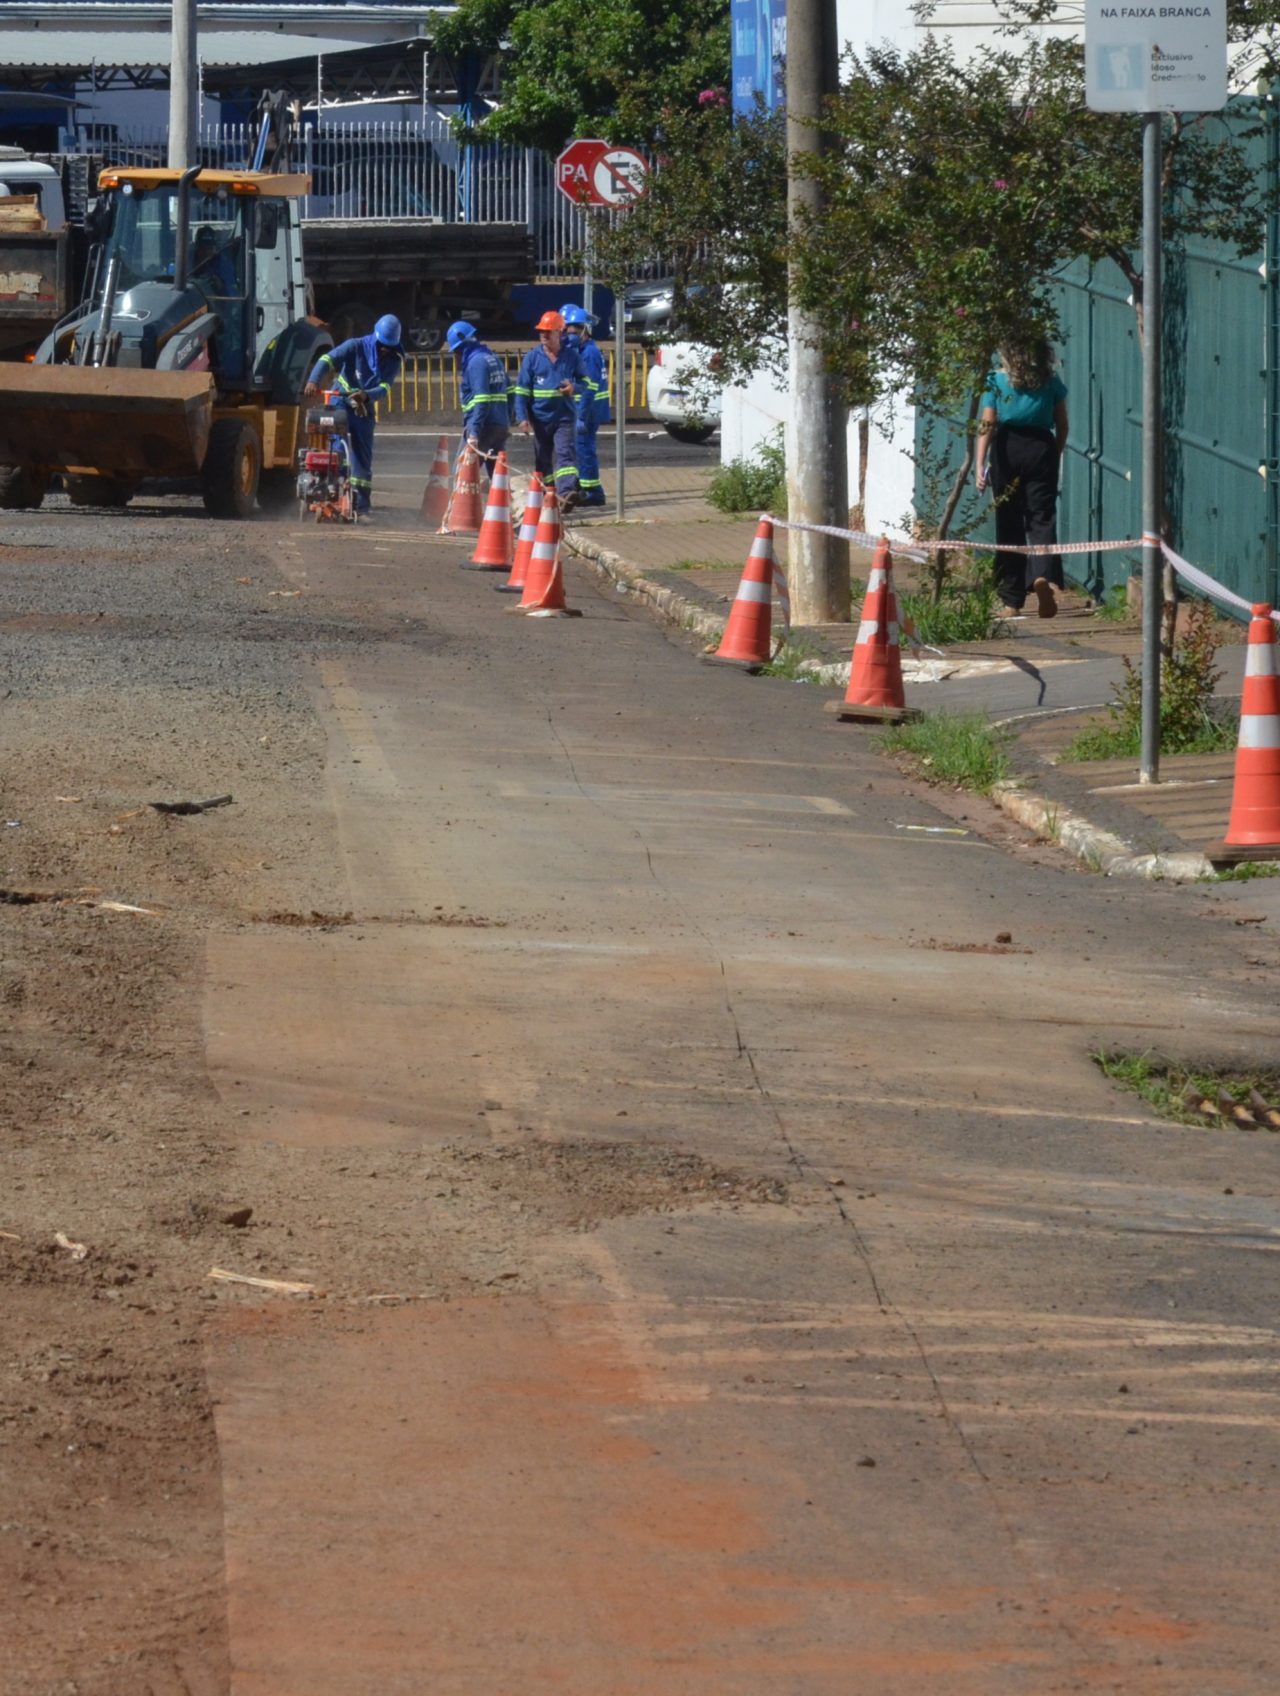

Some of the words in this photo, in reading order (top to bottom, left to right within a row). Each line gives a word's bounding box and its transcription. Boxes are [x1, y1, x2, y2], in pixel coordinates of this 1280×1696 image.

[1101, 8, 1118, 18] NA
[1121, 8, 1157, 18] FAIXA
[1159, 7, 1211, 17] BRANCA
[1151, 53, 1193, 61] Exclusivo
[561, 164, 588, 182] PA
